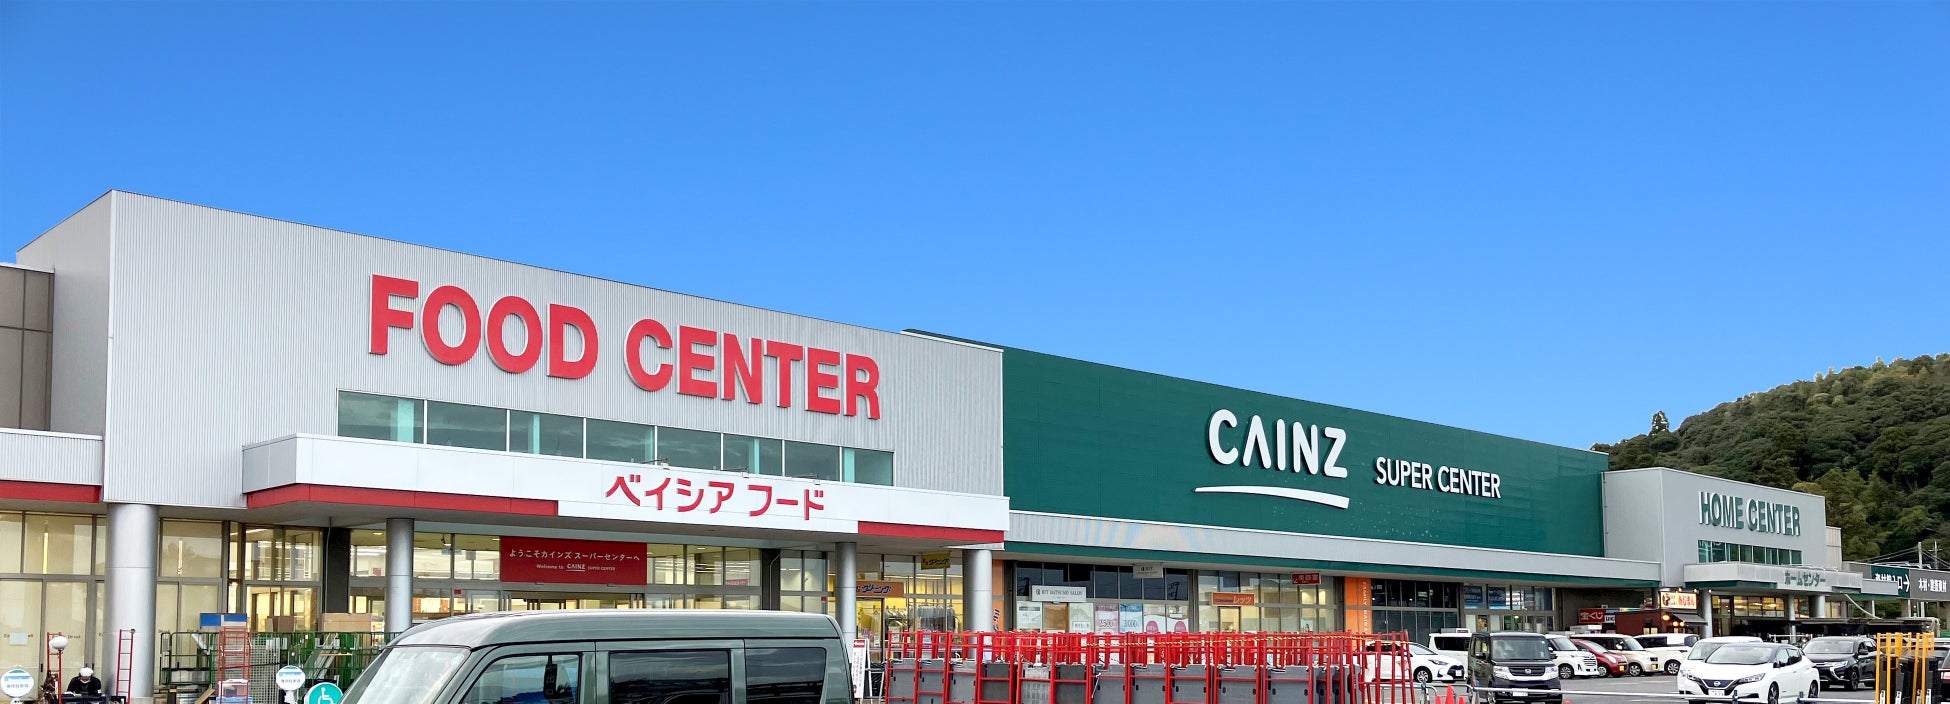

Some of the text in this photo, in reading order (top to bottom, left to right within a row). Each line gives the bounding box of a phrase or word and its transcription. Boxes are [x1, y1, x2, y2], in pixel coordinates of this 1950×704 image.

[368, 274, 881, 420] FOOD CENTER
[1207, 408, 1349, 479] CAINZ
[605, 474, 825, 521] ベイシア フード
[1375, 456, 1502, 499] SUPER CENTER
[1698, 491, 1801, 537] HOME CENTER
[509, 549, 641, 562] ようこそカインズ スーパーセンターへ
[1784, 570, 1827, 588] ホームセンター
[1580, 611, 1604, 621] 宝くじ
